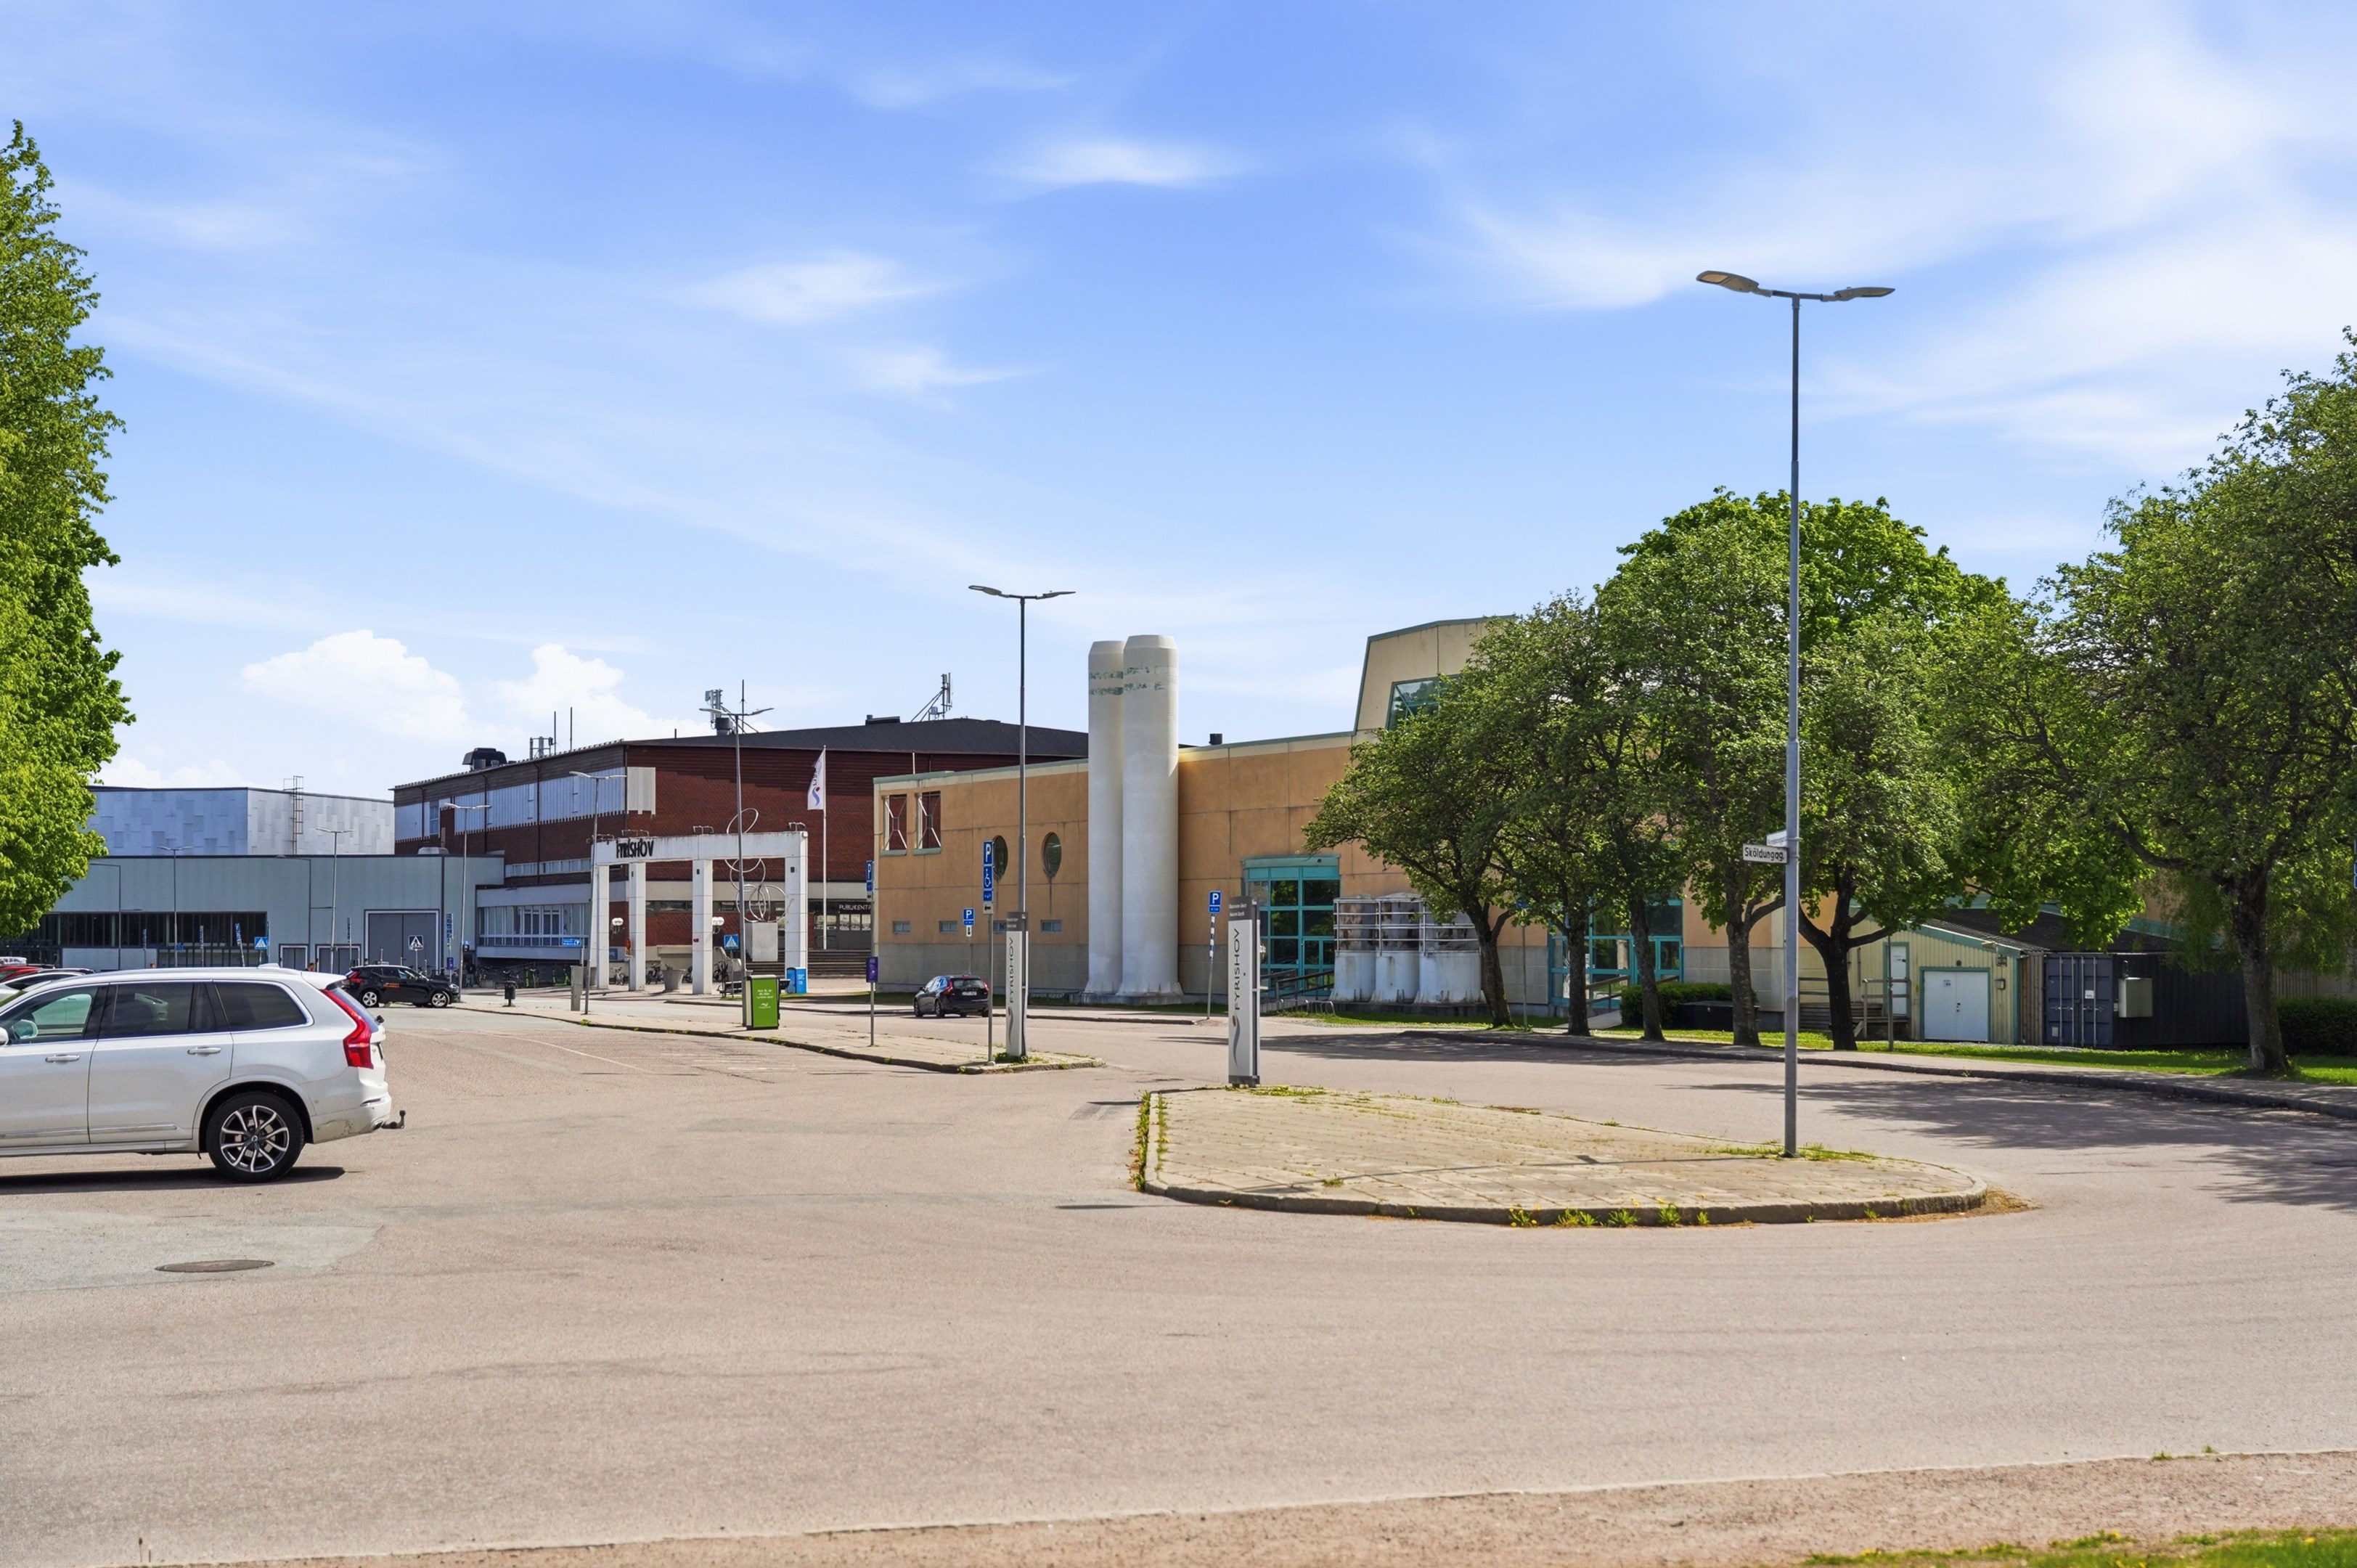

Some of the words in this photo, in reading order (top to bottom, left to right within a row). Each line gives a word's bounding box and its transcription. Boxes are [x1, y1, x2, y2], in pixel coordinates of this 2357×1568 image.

[986, 844, 992, 862] P
[1212, 893, 1220, 904] P
[965, 910, 972, 919] P
